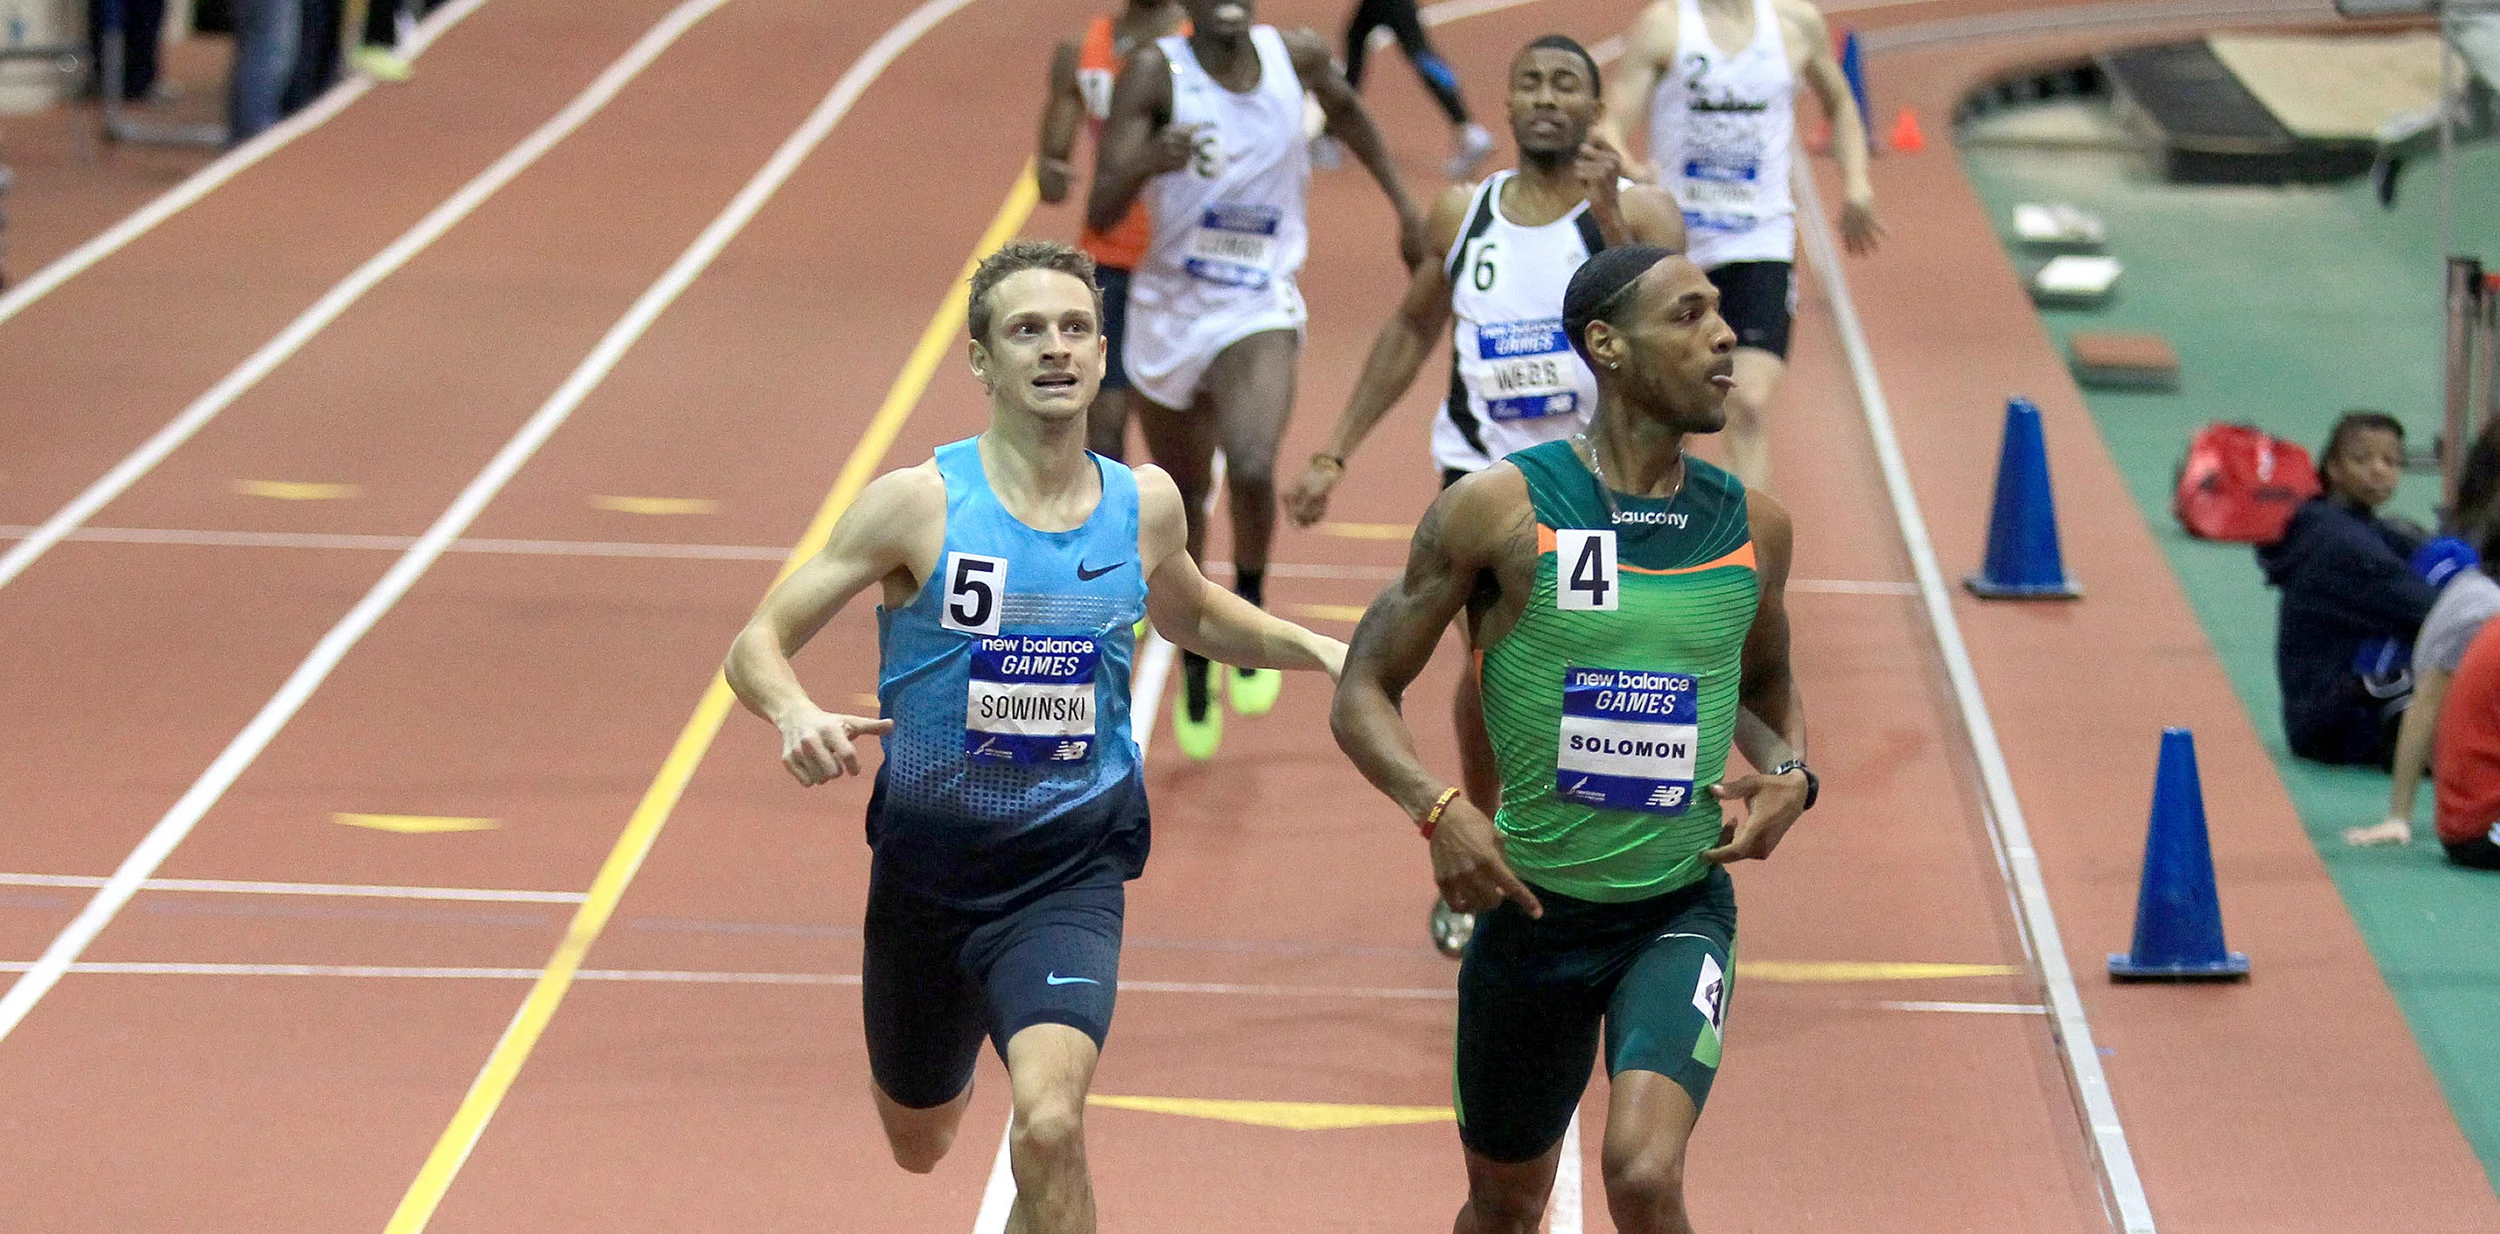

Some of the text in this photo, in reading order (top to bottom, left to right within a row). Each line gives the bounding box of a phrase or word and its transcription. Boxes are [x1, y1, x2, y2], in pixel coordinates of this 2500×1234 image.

[1686, 53, 1709, 93] 2
[1475, 244, 1497, 291] 6
[1493, 360, 1560, 390] WEBB
[1611, 511, 1689, 529] saucony
[1570, 536, 1609, 606] 4
[950, 558, 994, 627] 5
[982, 636, 1095, 654] new balance
[1001, 655, 1080, 676] GAMES
[1576, 671, 1690, 692] new balance
[981, 694, 1085, 721] SOWINSKI
[1595, 690, 1677, 715] GAMES
[1570, 735, 1686, 759] SOLOMON
[1704, 978, 1724, 1031] 4
